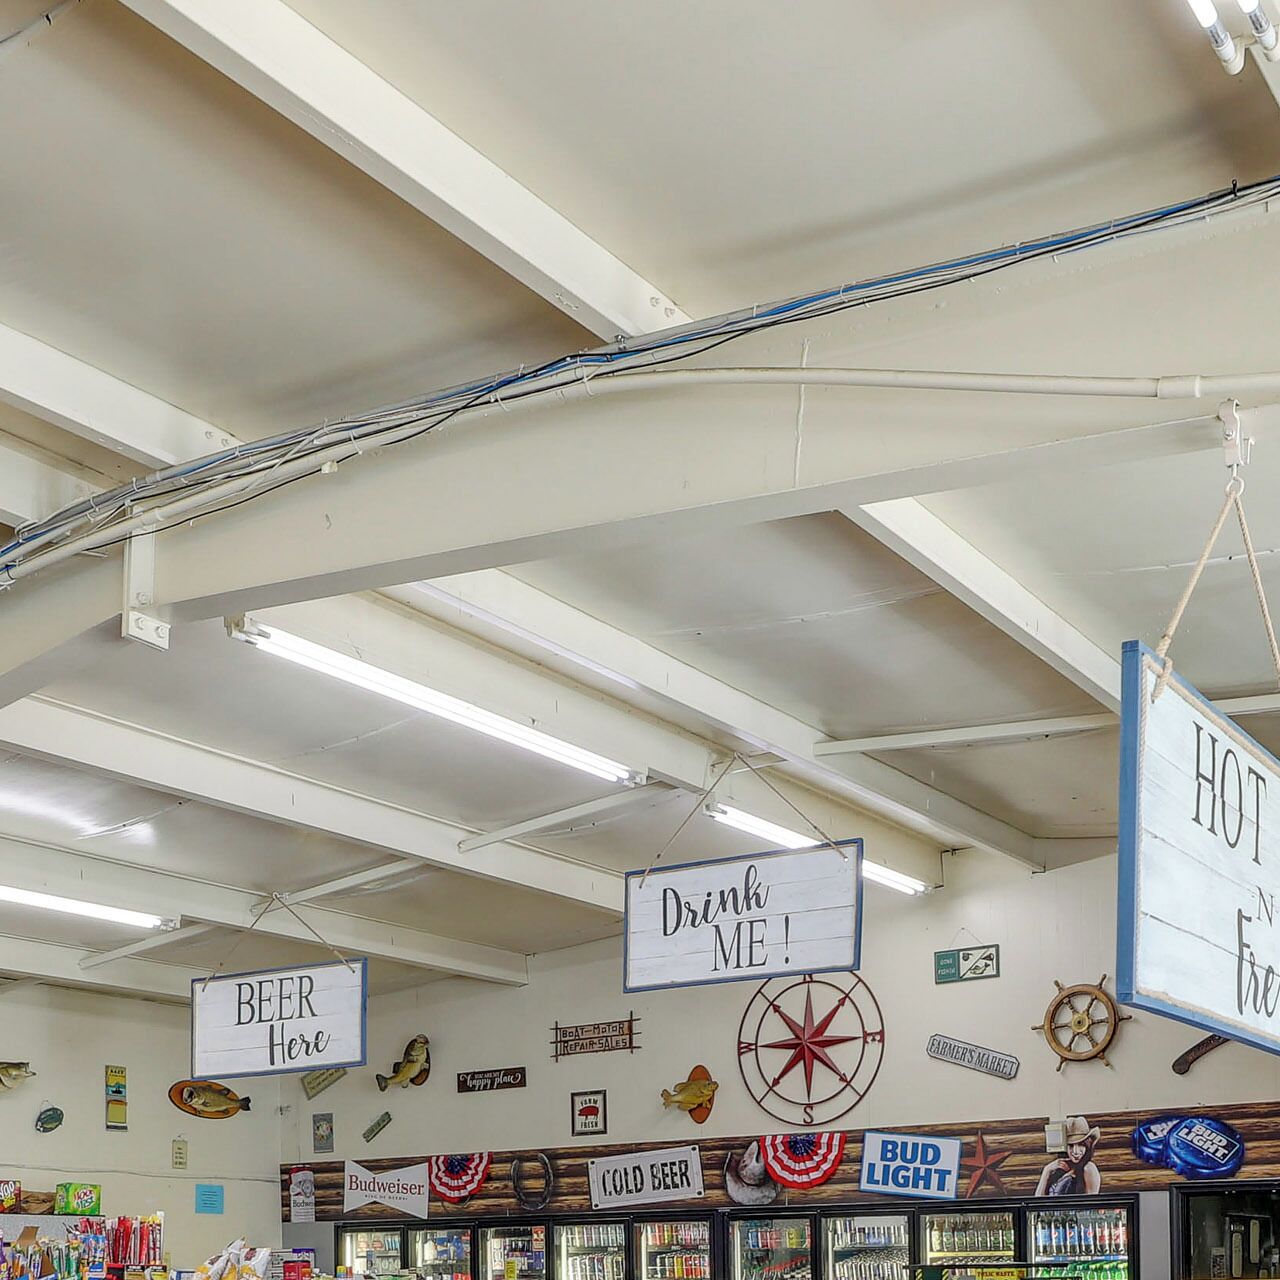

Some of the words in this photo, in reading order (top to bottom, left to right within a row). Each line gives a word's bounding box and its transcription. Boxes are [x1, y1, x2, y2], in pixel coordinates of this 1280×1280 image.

[1192, 720, 1267, 866] HOT
[662, 864, 770, 936] Drink
[1255, 885, 1275, 928] N
[711, 919, 768, 972] ME
[235, 976, 318, 1026] BEER
[270, 1022, 330, 1066] Here
[929, 1038, 974, 1063] FARMER'S
[974, 1050, 1017, 1077] MARKET
[880, 1139, 942, 1166] BUD
[1191, 1125, 1228, 1147] BUD
[348, 1173, 424, 1196] Budweiser
[602, 1166, 645, 1196] COLD
[651, 1160, 691, 1190] BEER
[867, 1163, 951, 1192] LIGHT
